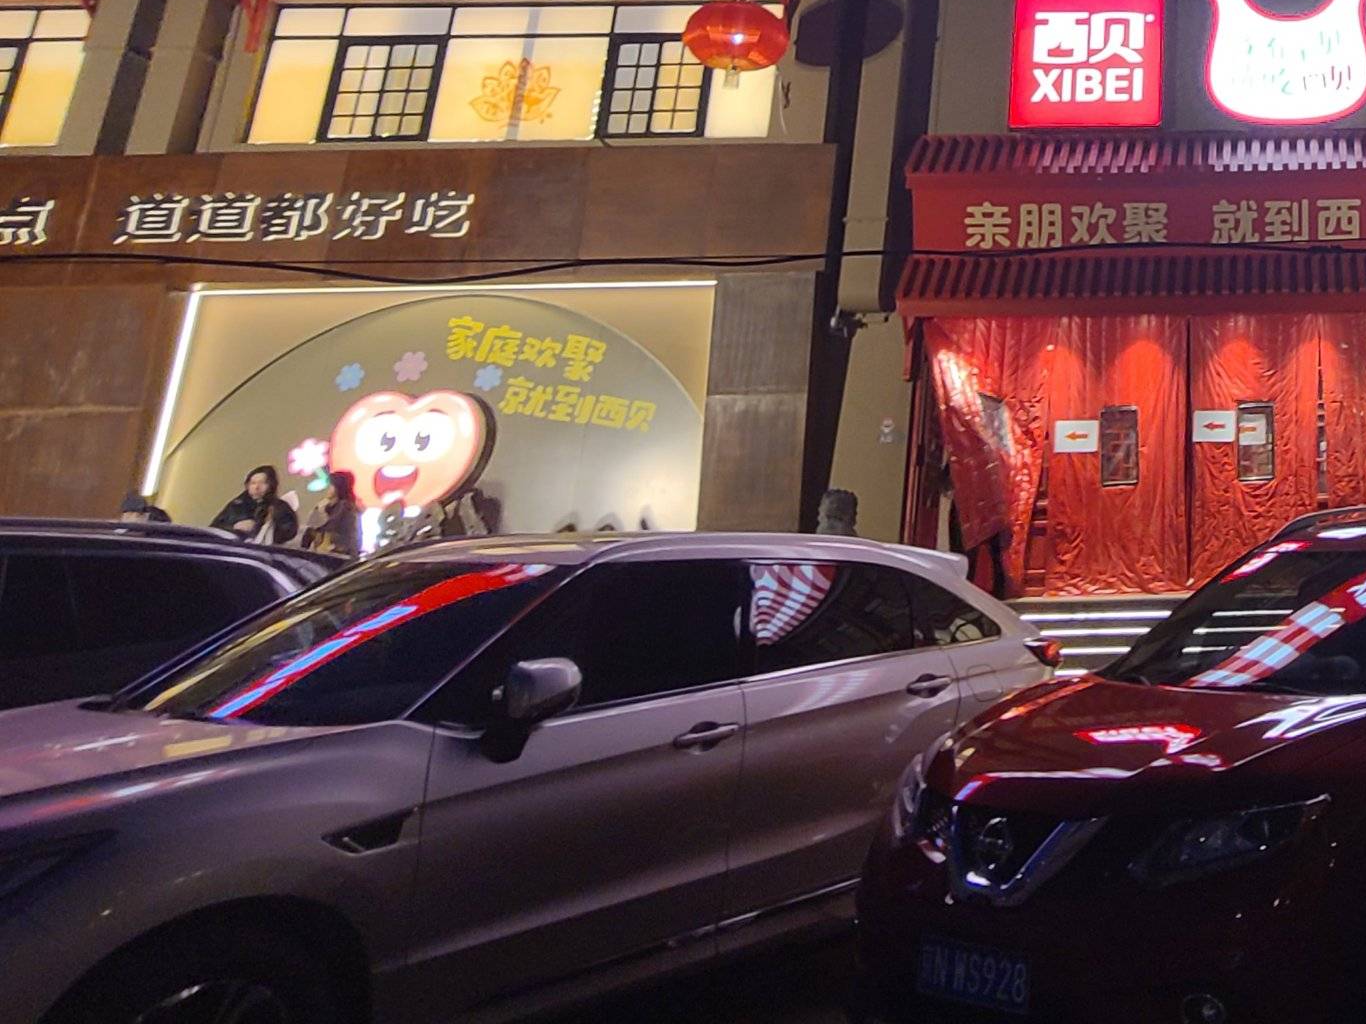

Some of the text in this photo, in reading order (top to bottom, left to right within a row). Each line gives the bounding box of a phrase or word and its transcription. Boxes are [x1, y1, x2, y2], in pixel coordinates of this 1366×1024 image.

[1032, 11, 1145, 65] 西贝
[1030, 68, 1144, 103] XIBEI
[113, 191, 475, 244] 道道都好吃
[964, 201, 1169, 250] 亲朋欢聚
[446, 316, 607, 382] 家庭欢聚
[499, 376, 657, 432] 就到西贝
